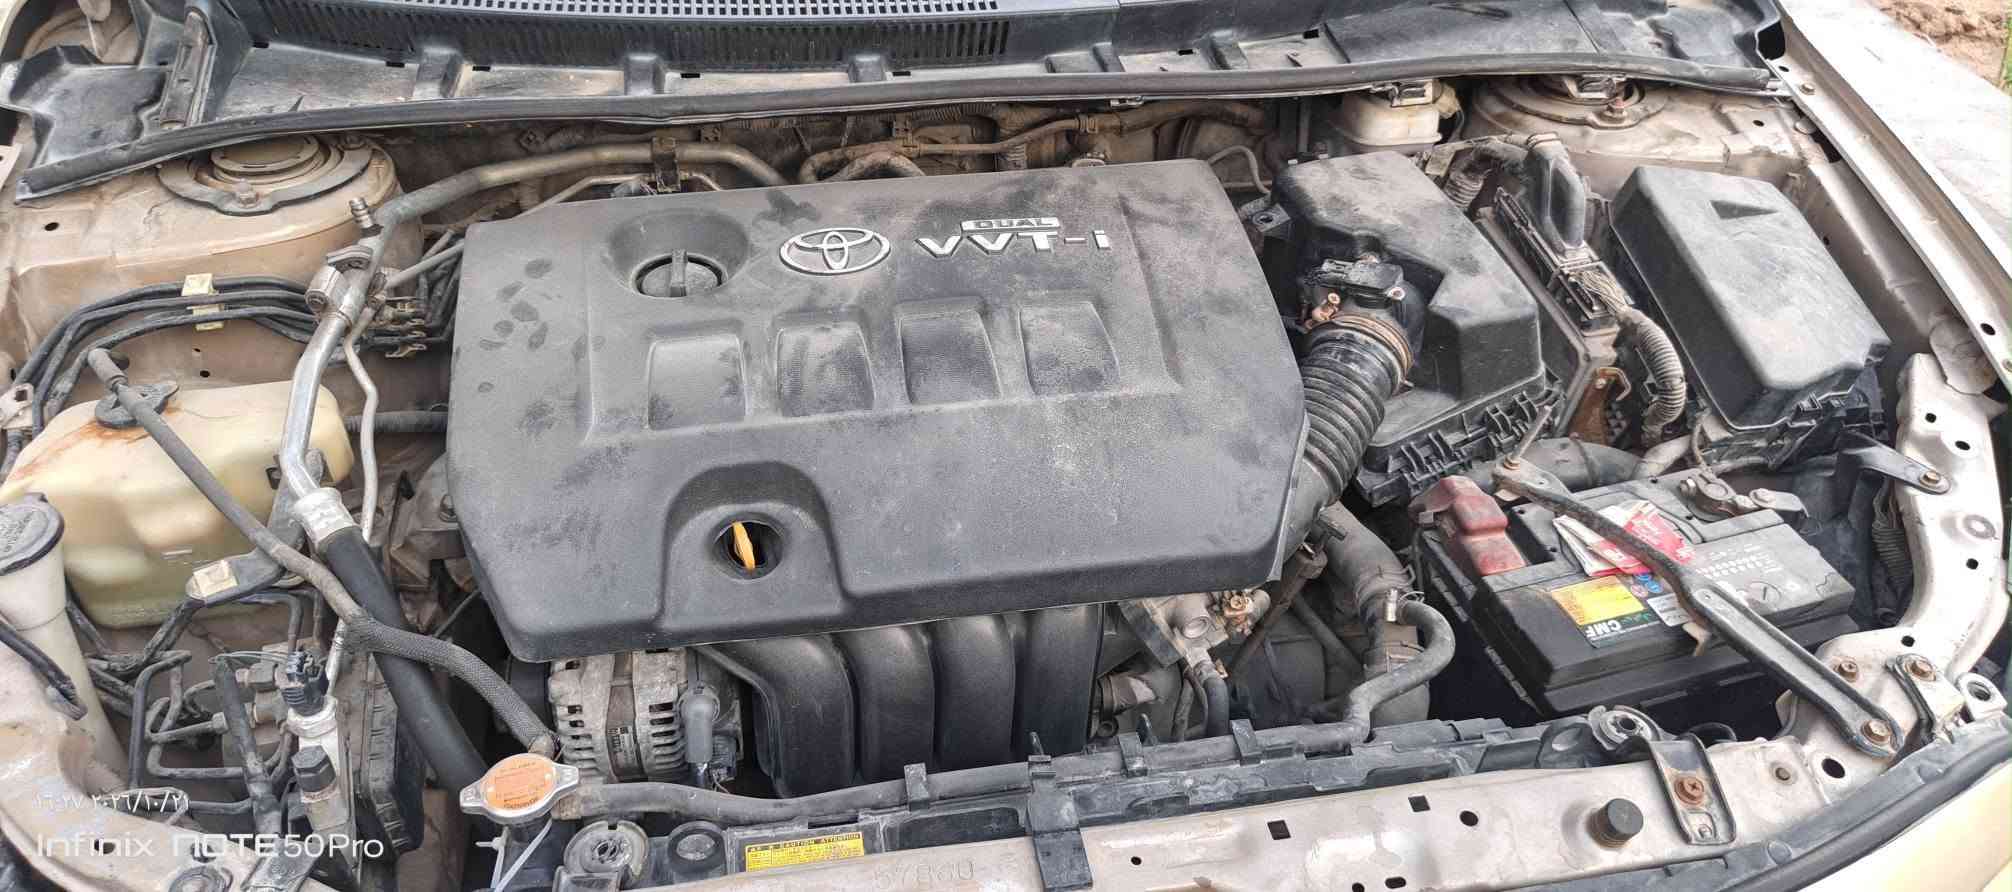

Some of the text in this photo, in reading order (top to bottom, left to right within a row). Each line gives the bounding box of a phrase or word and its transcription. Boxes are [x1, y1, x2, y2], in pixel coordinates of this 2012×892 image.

[969, 217, 1057, 230] DUAL
[915, 230, 1112, 258] VVT-i
[1585, 620, 1621, 637] CMF
